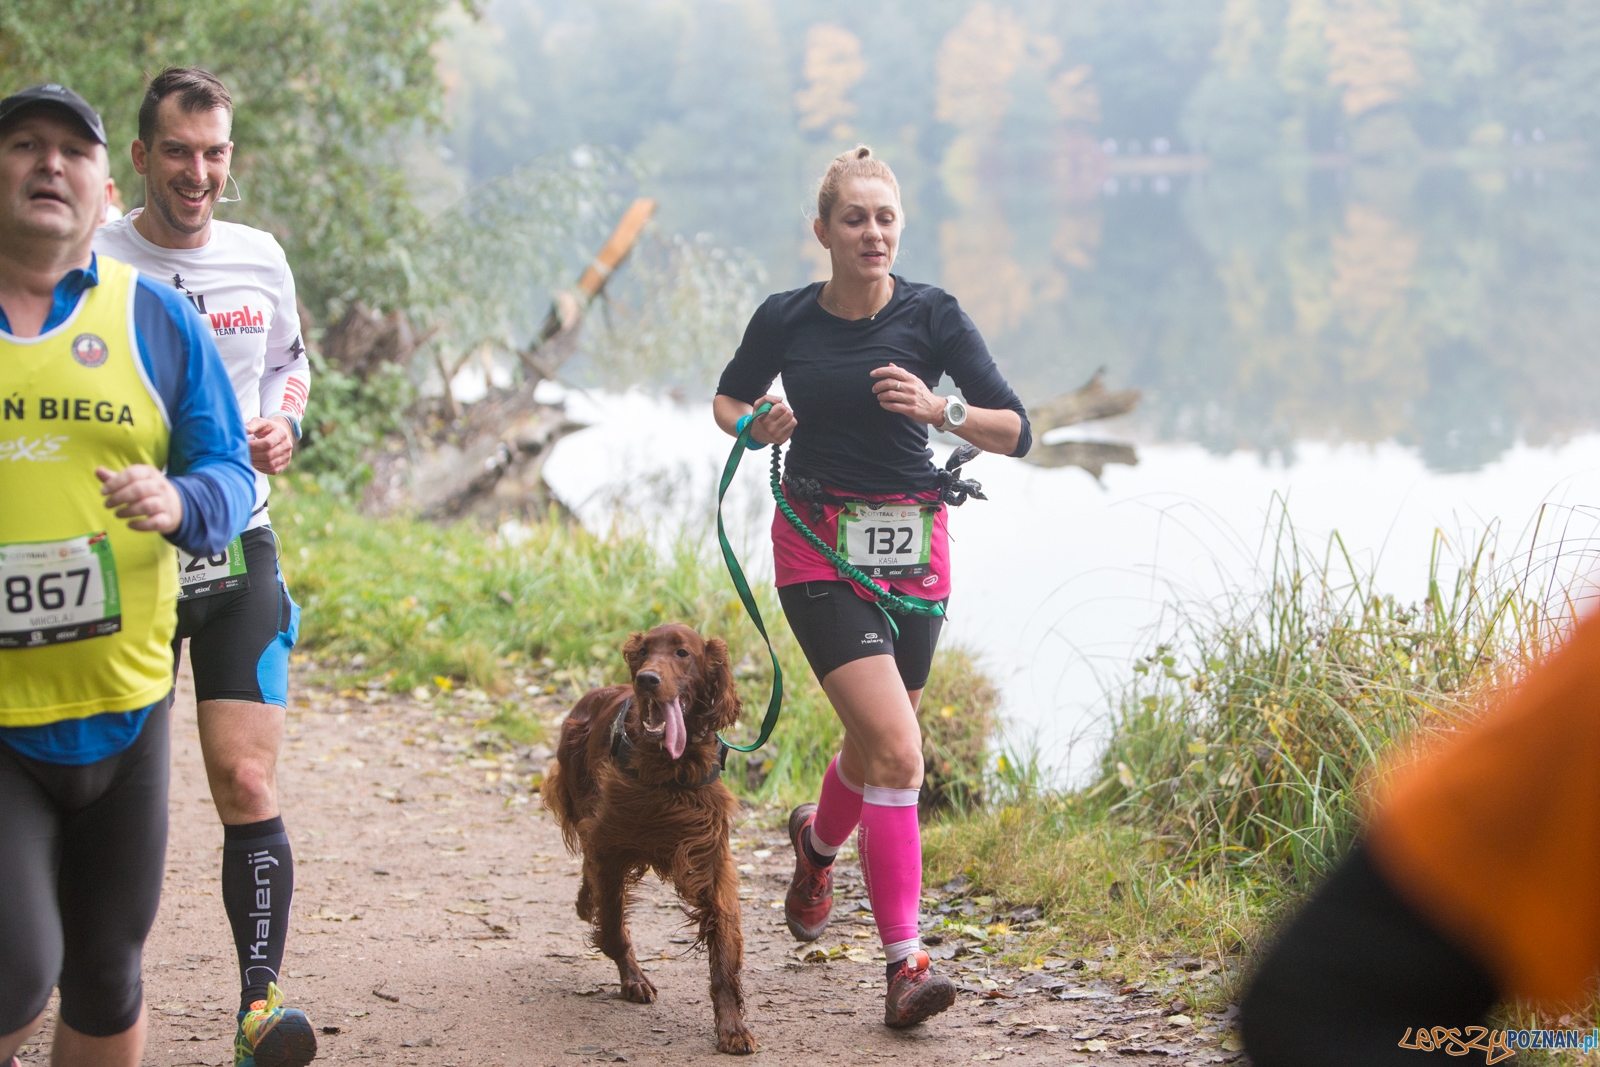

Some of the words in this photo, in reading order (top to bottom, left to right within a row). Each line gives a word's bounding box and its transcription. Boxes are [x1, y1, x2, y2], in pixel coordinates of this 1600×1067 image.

[214, 328, 236, 336] TEAM
[40, 398, 134, 426] BIEGA
[864, 526, 913, 555] 132
[878, 557, 898, 565] KASIA
[178, 573, 207, 585] OMASZ
[4, 567, 91, 614] 867
